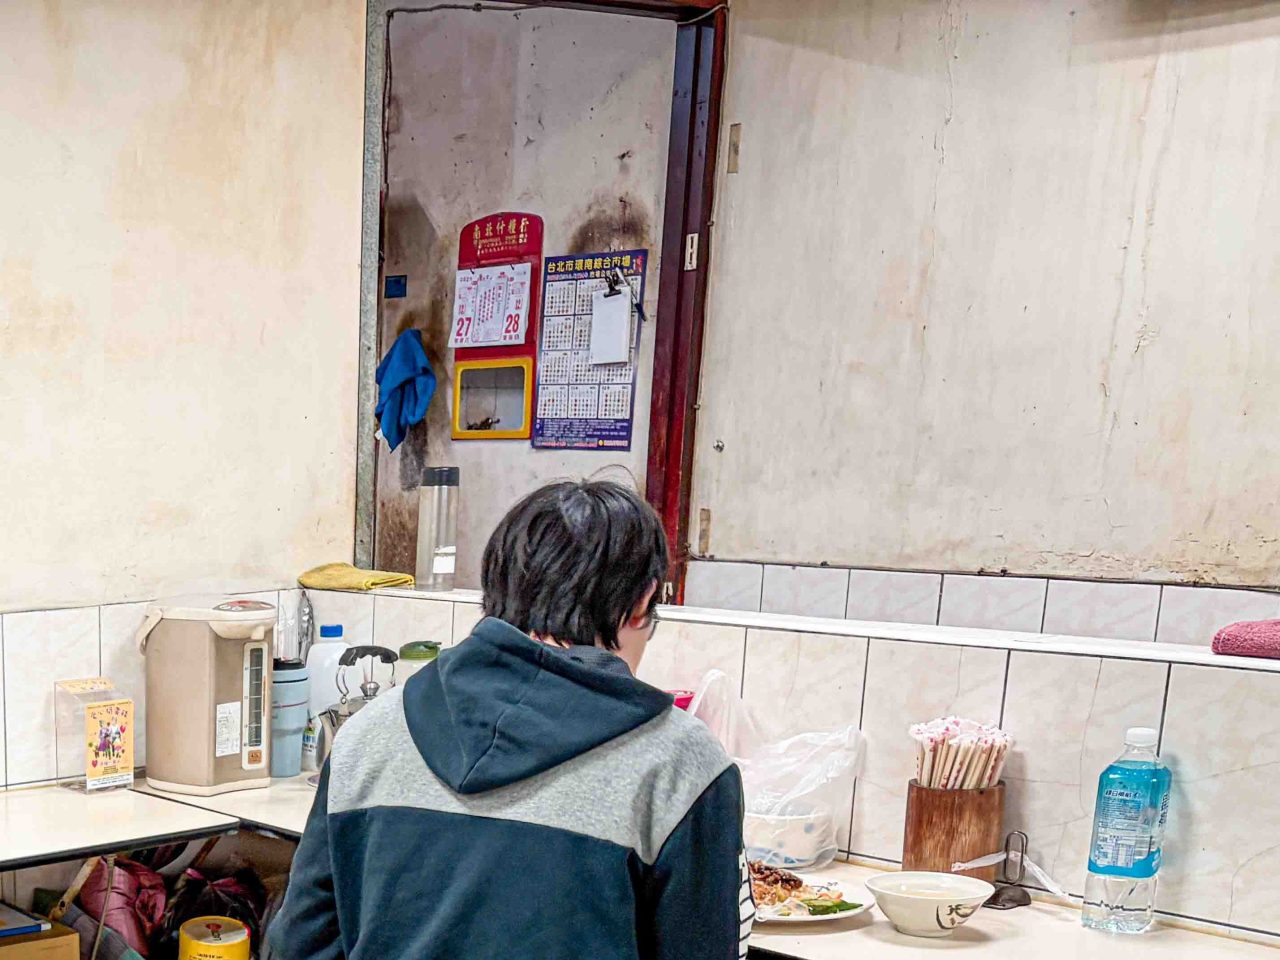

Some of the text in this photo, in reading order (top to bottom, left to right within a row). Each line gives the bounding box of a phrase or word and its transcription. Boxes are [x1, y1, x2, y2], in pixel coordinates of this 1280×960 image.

[548, 255, 631, 273] 台北市環南綜合市場
[456, 313, 520, 337] 27 28
